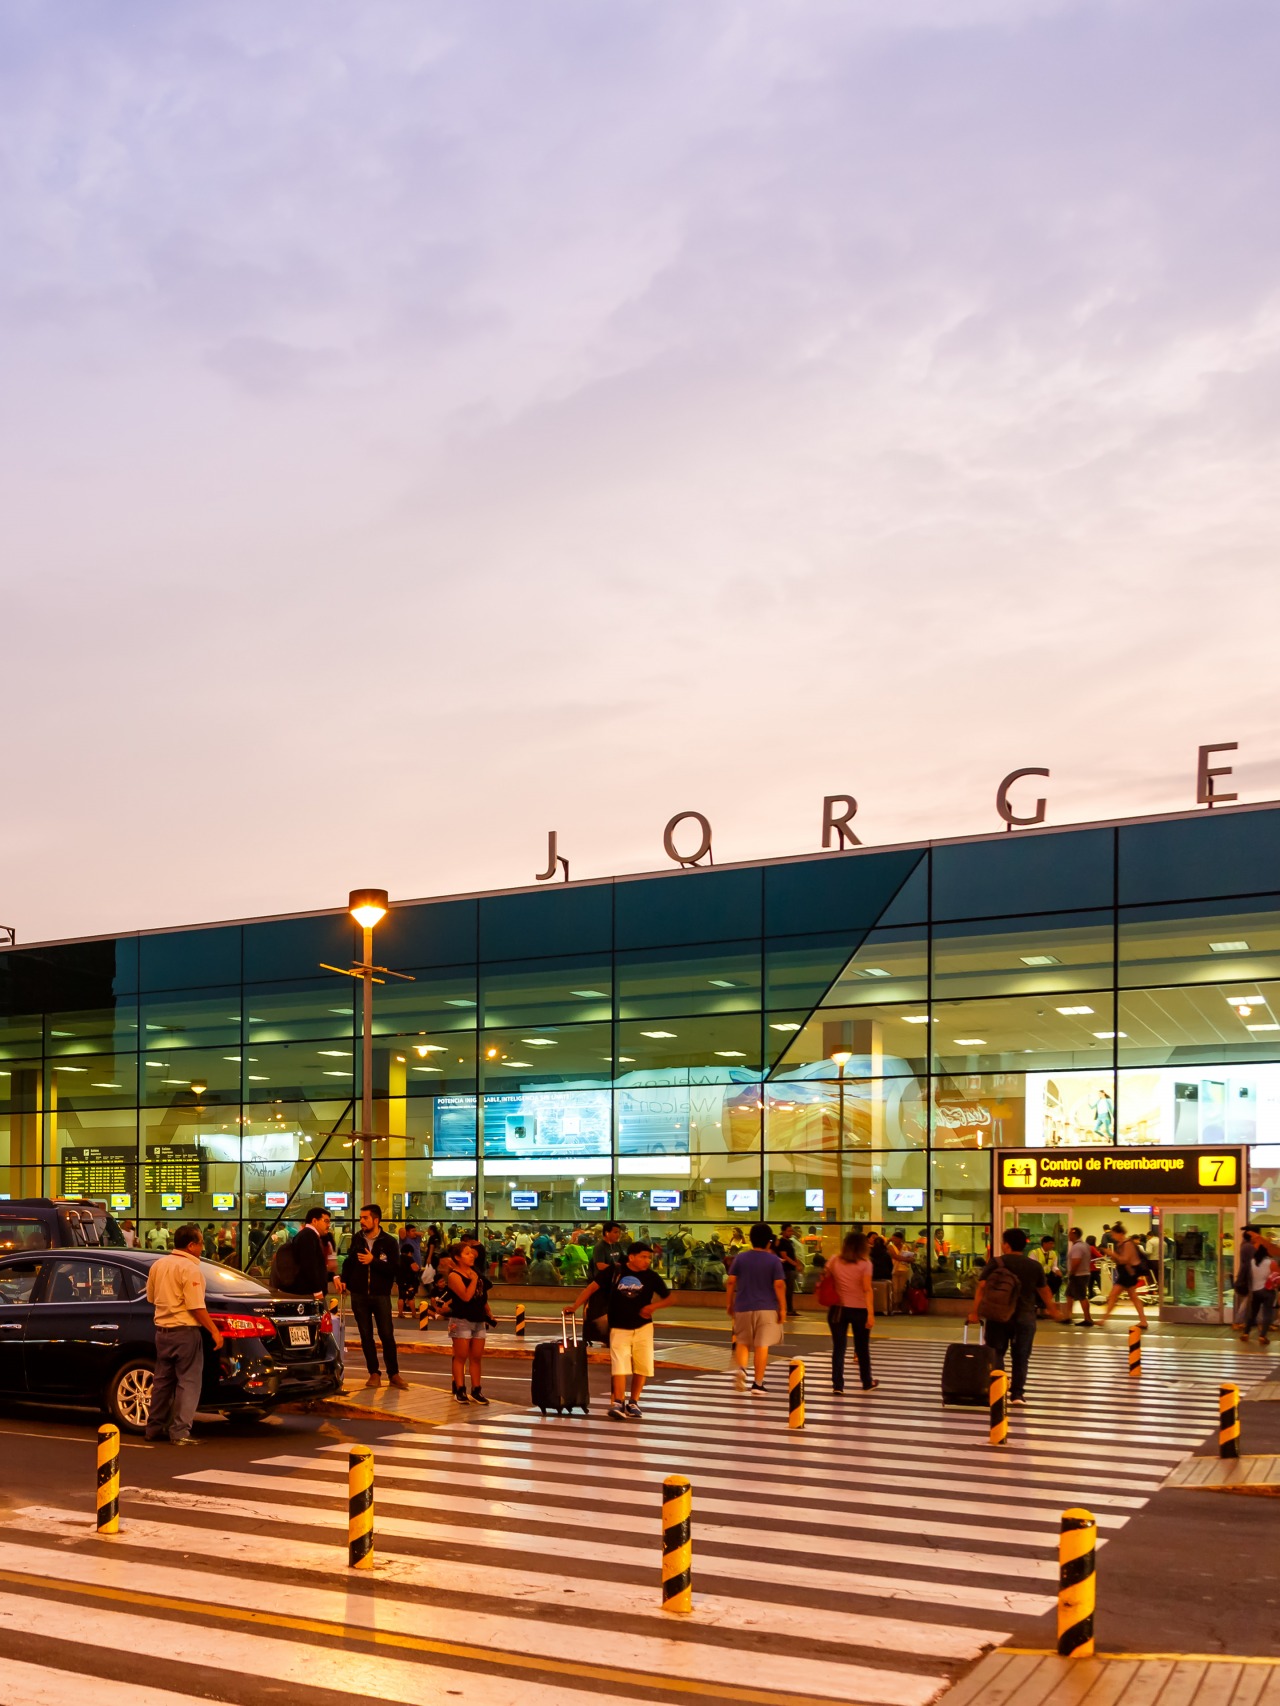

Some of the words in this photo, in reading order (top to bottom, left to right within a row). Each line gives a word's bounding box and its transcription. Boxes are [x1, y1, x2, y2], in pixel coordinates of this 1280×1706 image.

[535, 741, 1239, 881] JORGE
[1040, 1157, 1083, 1171] Control
[1085, 1157, 1102, 1170] de
[1103, 1157, 1184, 1172] Preembarque
[1209, 1160, 1225, 1182] 7
[1039, 1177, 1070, 1188] Check
[1071, 1177, 1081, 1187] In
